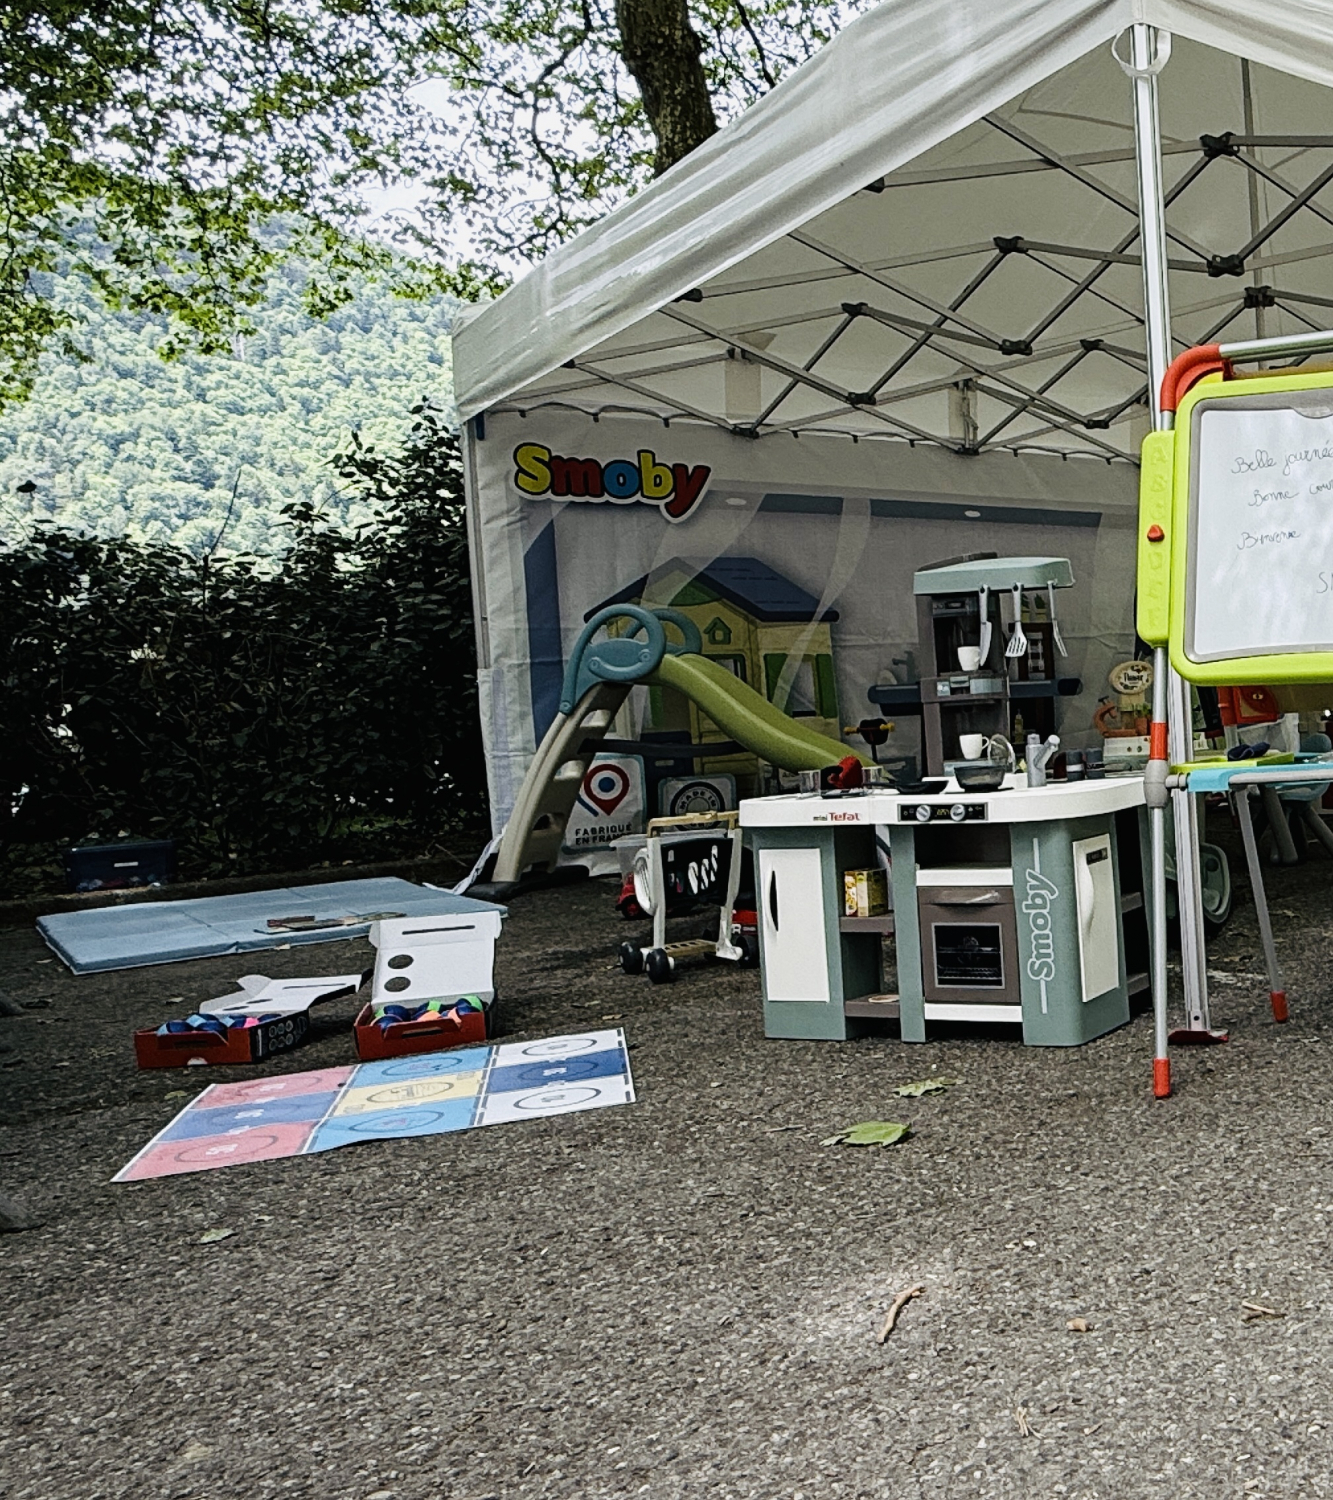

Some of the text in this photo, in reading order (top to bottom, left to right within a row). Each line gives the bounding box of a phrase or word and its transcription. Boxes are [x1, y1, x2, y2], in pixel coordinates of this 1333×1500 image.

[1231, 449, 1277, 474] Belle
[513, 442, 711, 518] Smoby
[1248, 489, 1300, 507] Bonne
[680, 790, 706, 809] MADE
[828, 812, 860, 821] Tefal
[575, 821, 632, 837] FABRIQUÉ
[575, 832, 629, 845] EN FRAN
[1022, 869, 1059, 981] Smoby
